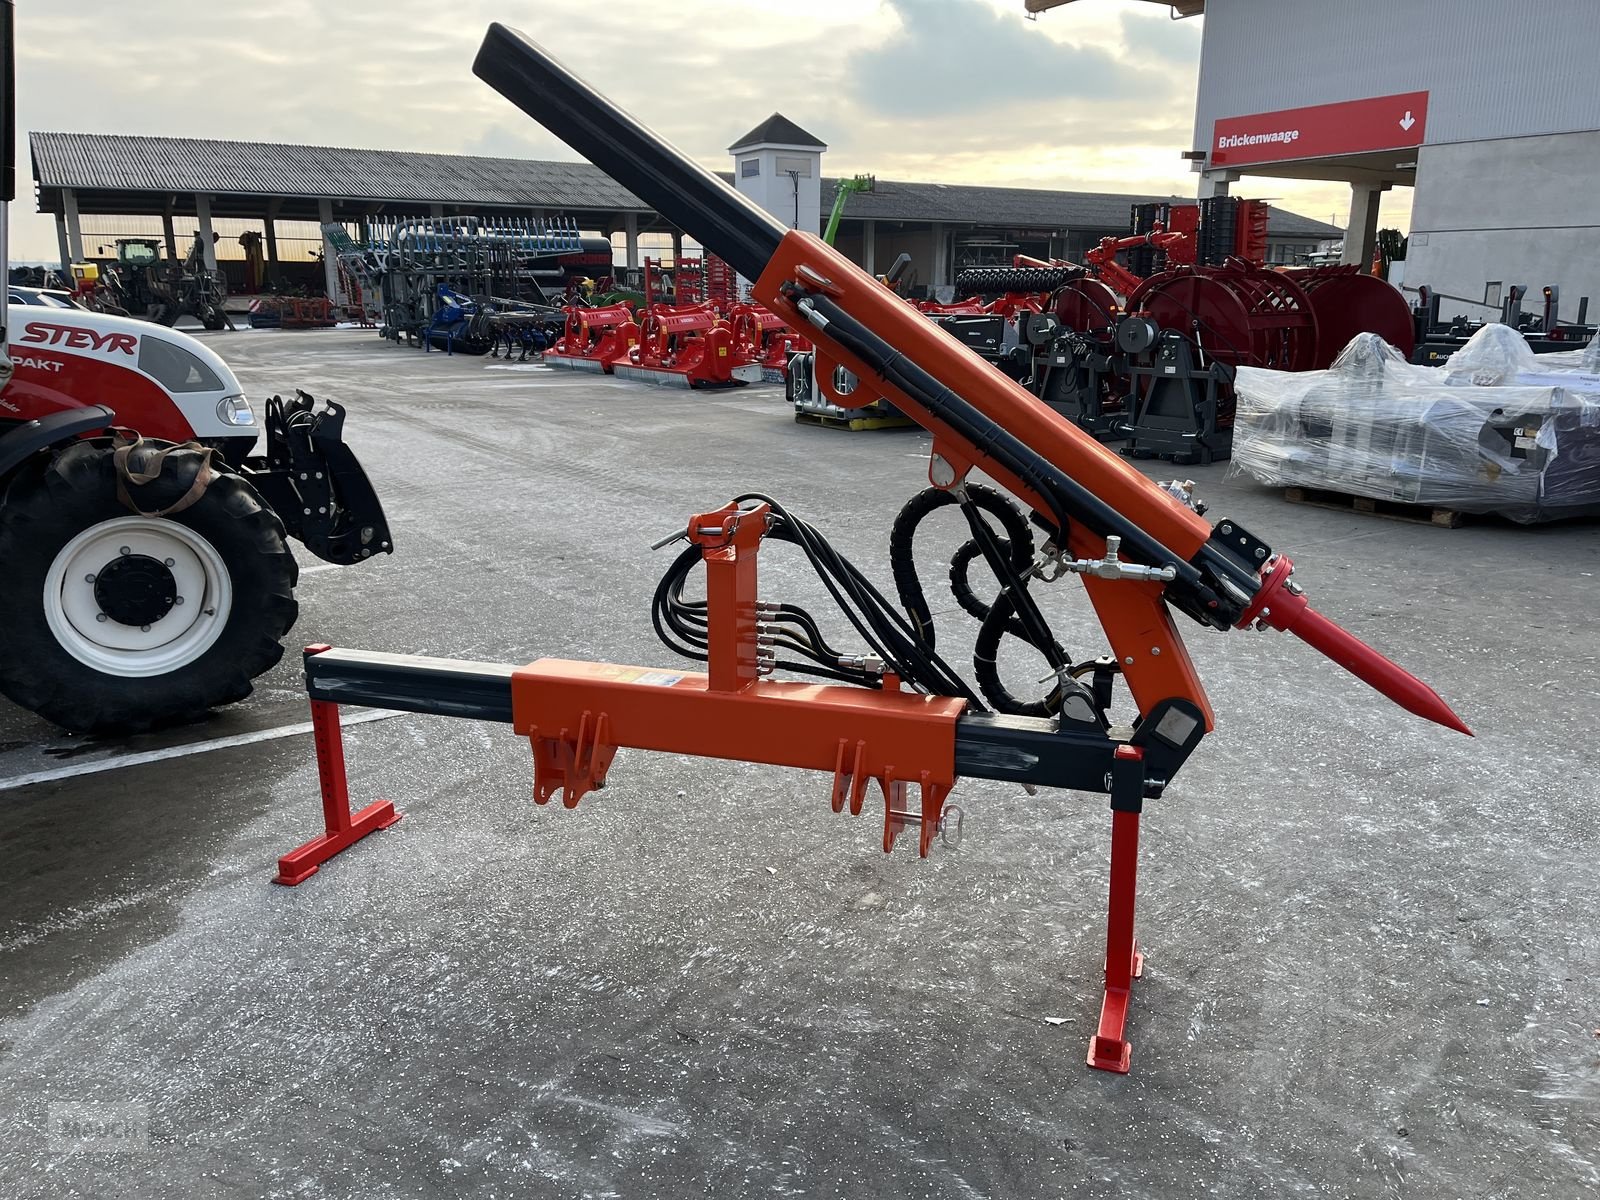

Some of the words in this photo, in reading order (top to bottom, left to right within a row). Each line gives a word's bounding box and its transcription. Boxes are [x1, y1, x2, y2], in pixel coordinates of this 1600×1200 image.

[1218, 130, 1299, 149] Brückenwaage
[20, 322, 137, 355] STEYR
[9, 355, 65, 372] PAKT
